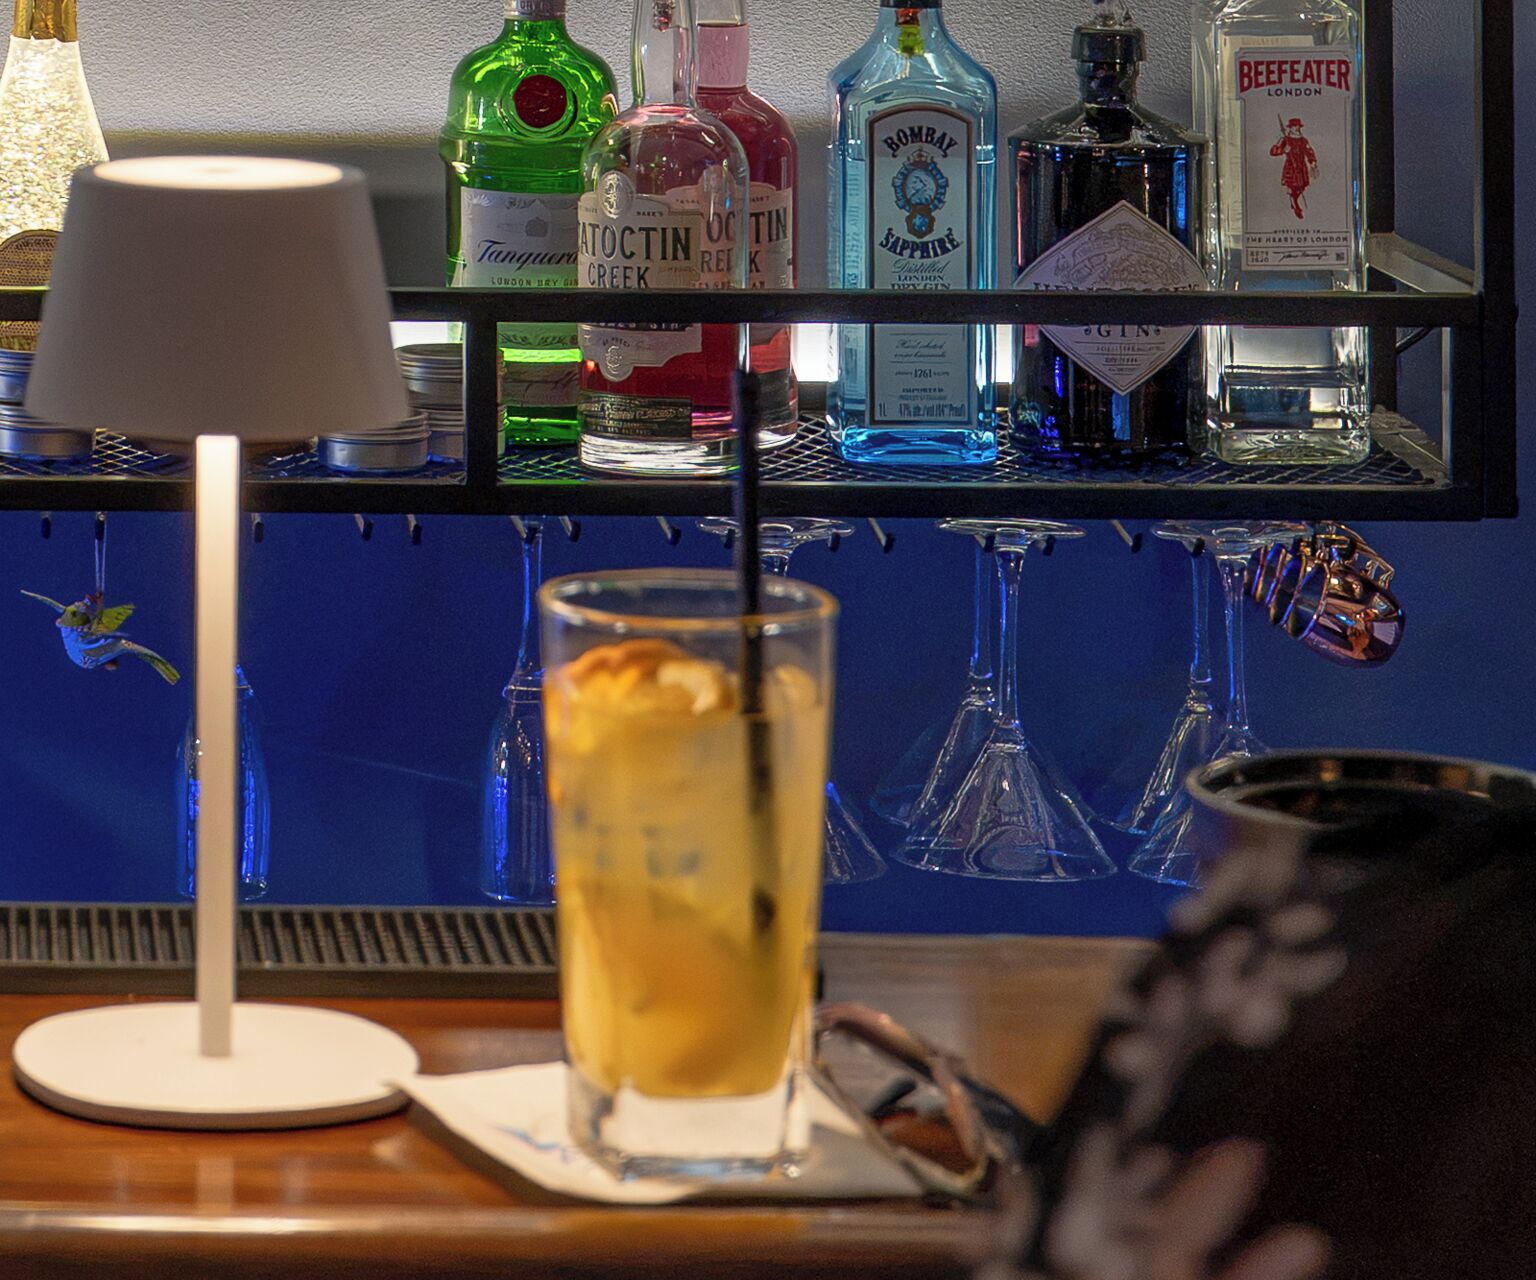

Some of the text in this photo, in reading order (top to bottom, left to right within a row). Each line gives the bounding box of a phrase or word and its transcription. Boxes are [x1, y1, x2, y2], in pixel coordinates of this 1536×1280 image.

[1238, 58, 1353, 92] BEEFEATER
[1266, 87, 1324, 97] LONDON
[883, 124, 959, 159] BOMBAY
[579, 224, 692, 262] ATOCTIN
[879, 226, 963, 260] SAPPHIRE
[587, 261, 650, 289] CREEK
[891, 258, 951, 275] Distilled
[490, 277, 531, 287] LONDON
[897, 273, 946, 283] LONDON
[1096, 326, 1151, 338] GIN
[913, 368, 932, 378] 1761
